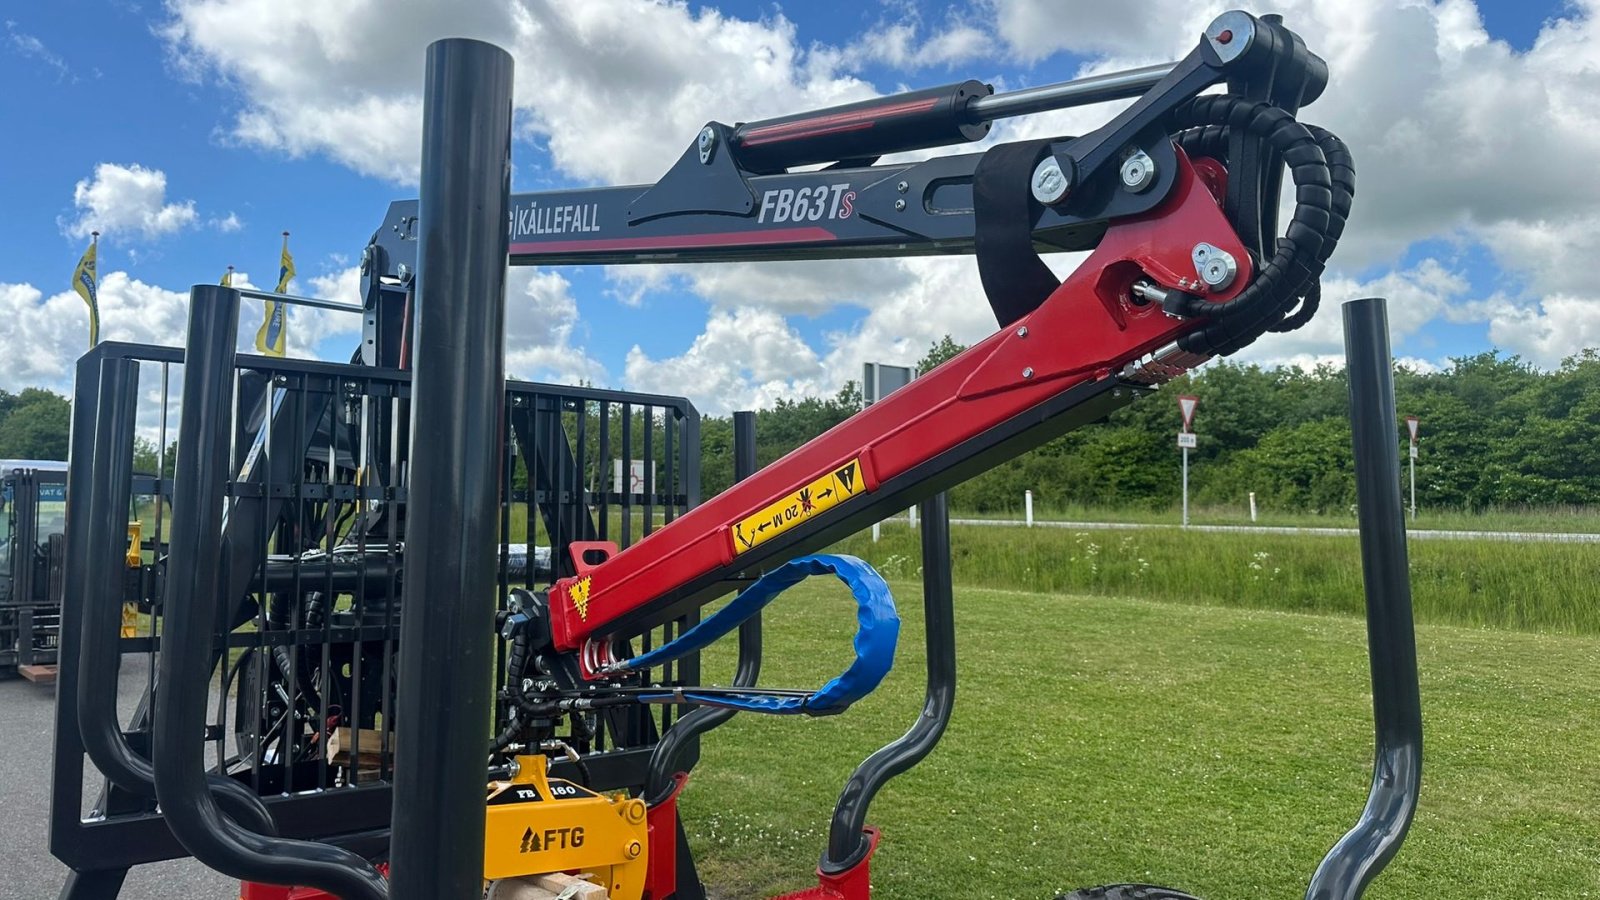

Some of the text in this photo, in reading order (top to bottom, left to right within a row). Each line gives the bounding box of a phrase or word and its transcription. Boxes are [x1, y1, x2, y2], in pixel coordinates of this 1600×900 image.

[772, 504, 799, 528] 20 M
[516, 785, 576, 799] FB 160
[543, 826, 585, 851] FTG
